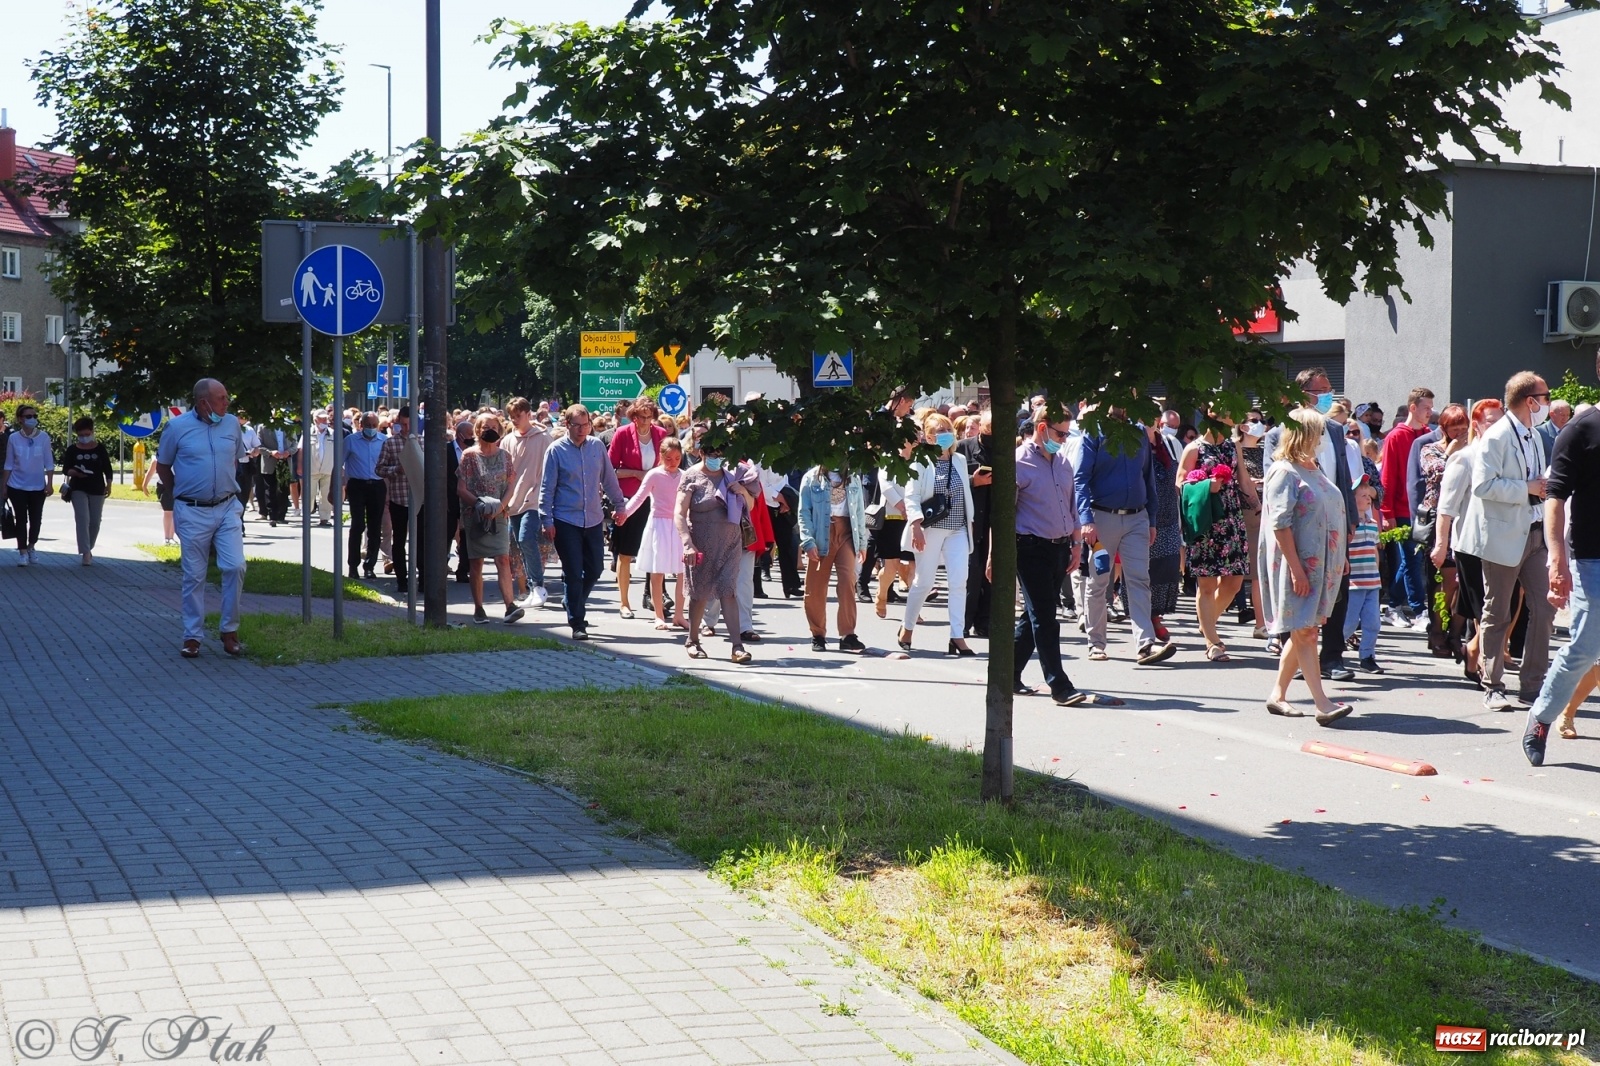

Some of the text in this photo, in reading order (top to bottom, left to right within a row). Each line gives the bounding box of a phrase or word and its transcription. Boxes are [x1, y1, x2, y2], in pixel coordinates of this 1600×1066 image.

[583, 334, 607, 343] Objazd
[583, 346, 621, 355] do Rybnika
[598, 360, 620, 370] Opole
[598, 376, 634, 386] Pietraszyn
[598, 387, 623, 397] Opava
